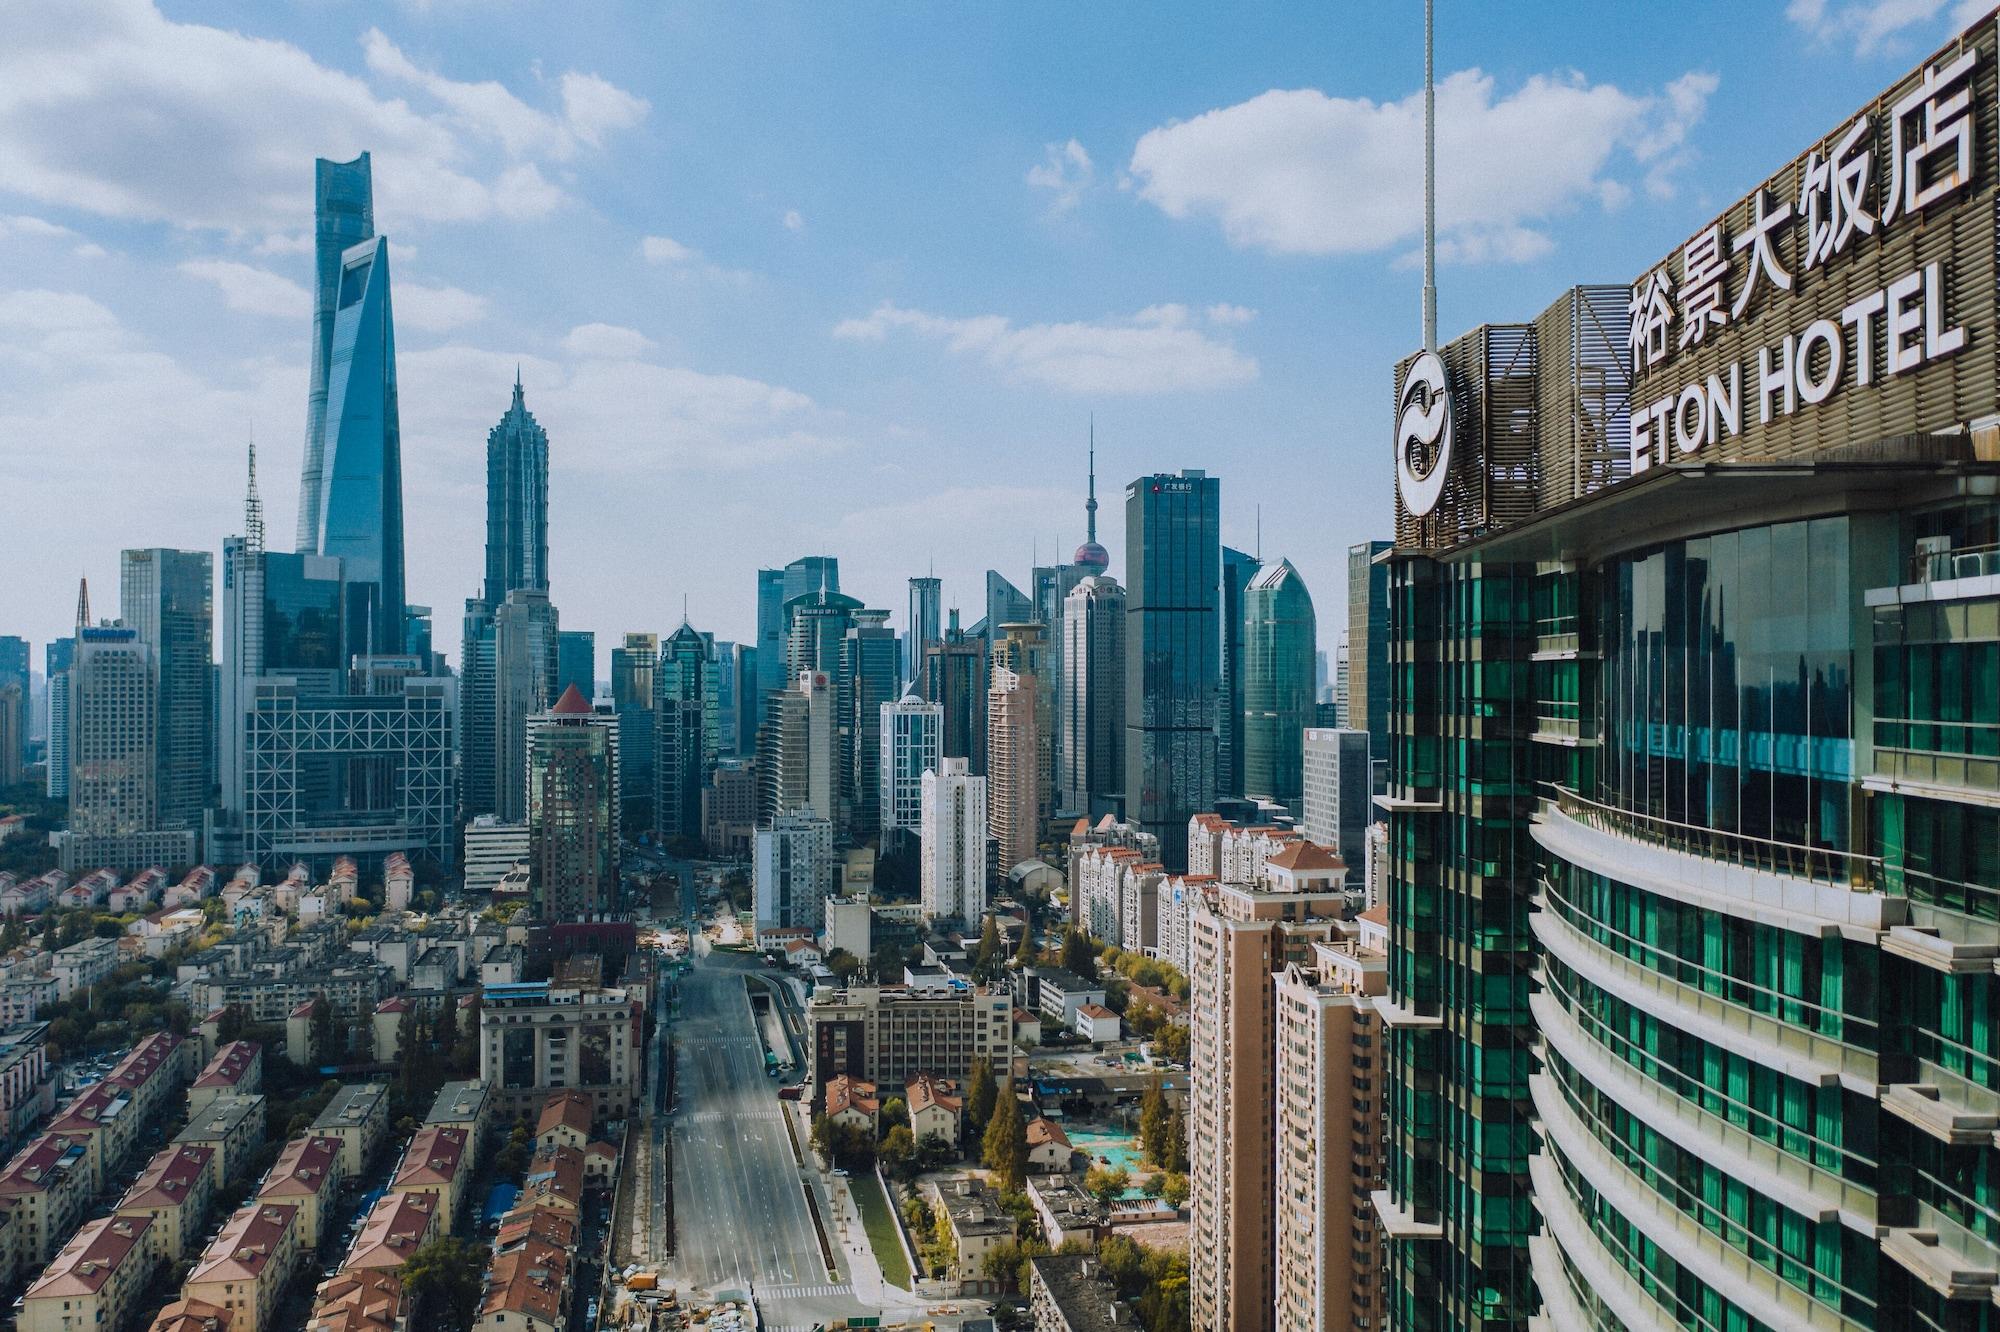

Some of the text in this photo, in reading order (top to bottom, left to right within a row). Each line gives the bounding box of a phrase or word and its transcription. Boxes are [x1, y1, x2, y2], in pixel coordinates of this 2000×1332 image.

[1628, 48, 1979, 373] 裕景大饭店
[1630, 261, 1969, 476] ETON HOTEL
